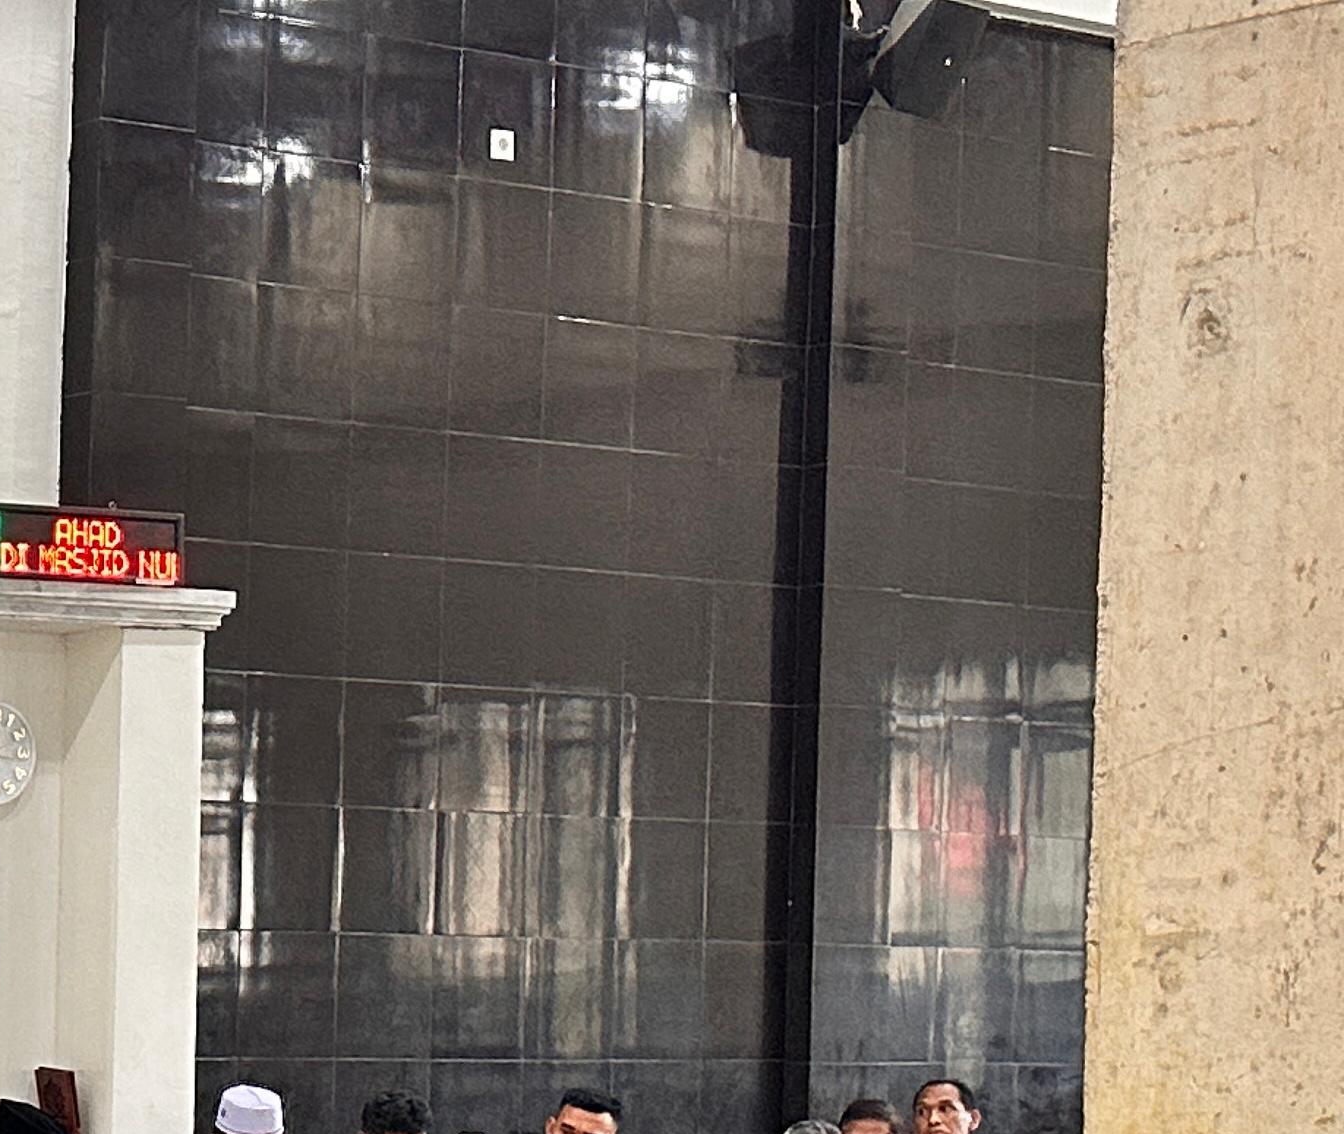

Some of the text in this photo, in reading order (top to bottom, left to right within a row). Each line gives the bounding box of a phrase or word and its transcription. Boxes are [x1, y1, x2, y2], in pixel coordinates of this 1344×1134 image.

[55, 517, 123, 549] AHAD
[0, 542, 28, 572] DI
[38, 545, 130, 577] MASJID
[7, 713, 16, 727] 1
[12, 727, 26, 741] 2
[17, 746, 30, 759] 3
[14, 766, 27, 781] 4
[2, 779, 16, 795] 5
